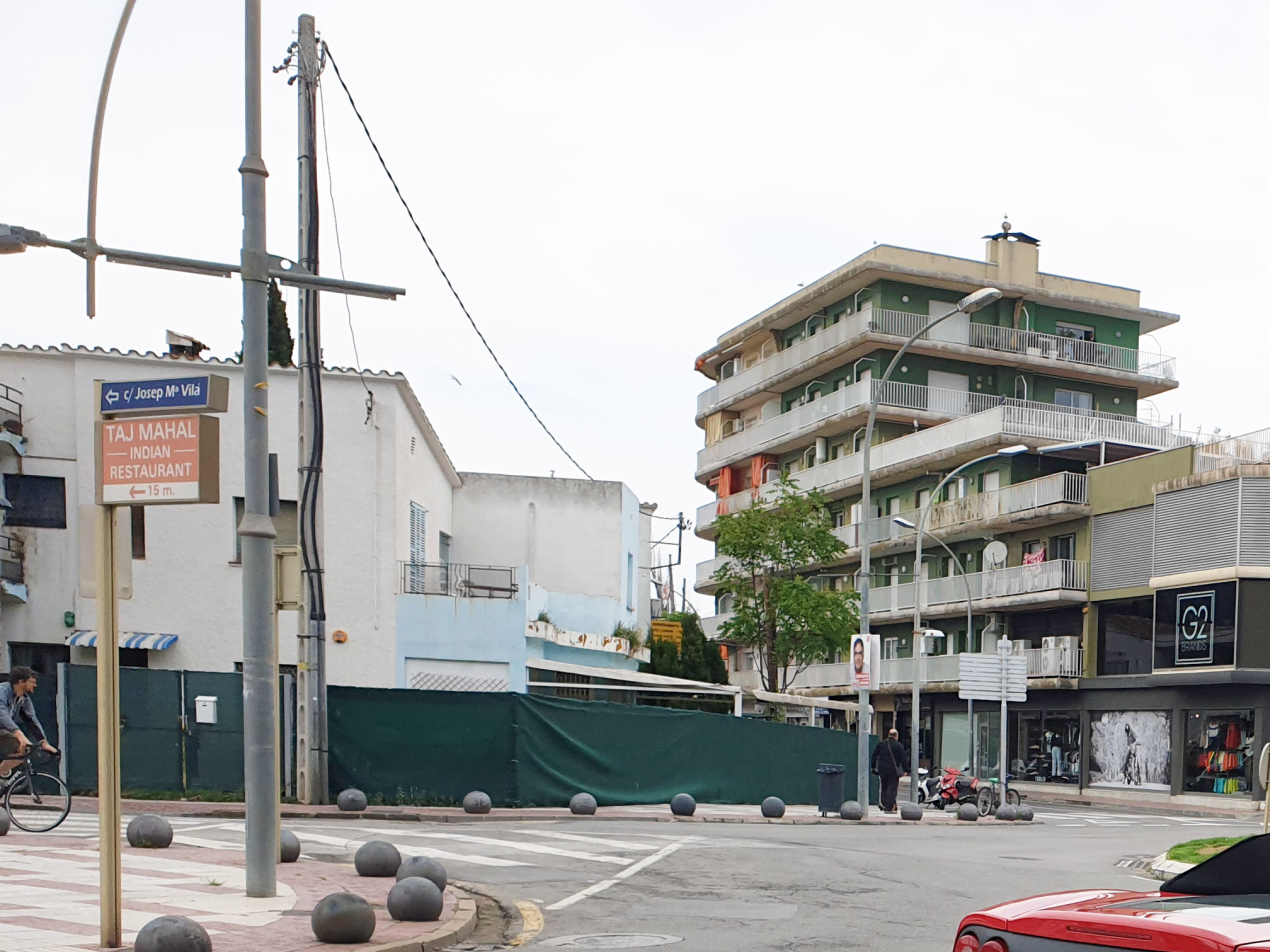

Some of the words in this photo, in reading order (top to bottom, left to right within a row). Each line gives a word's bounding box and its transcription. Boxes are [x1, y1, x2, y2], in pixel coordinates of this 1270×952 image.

[123, 387, 134, 403] c/
[135, 387, 163, 402] Josep
[181, 382, 201, 397] Vilá
[105, 424, 134, 443] TAJ
[139, 420, 196, 441] MAHAL
[130, 445, 171, 460] INDIAN
[110, 462, 192, 480] RESTAURANT
[148, 484, 160, 497] 15
[163, 487, 175, 497] m.
[1182, 605, 1208, 640] G2
[1181, 640, 1207, 652] BRANDS
